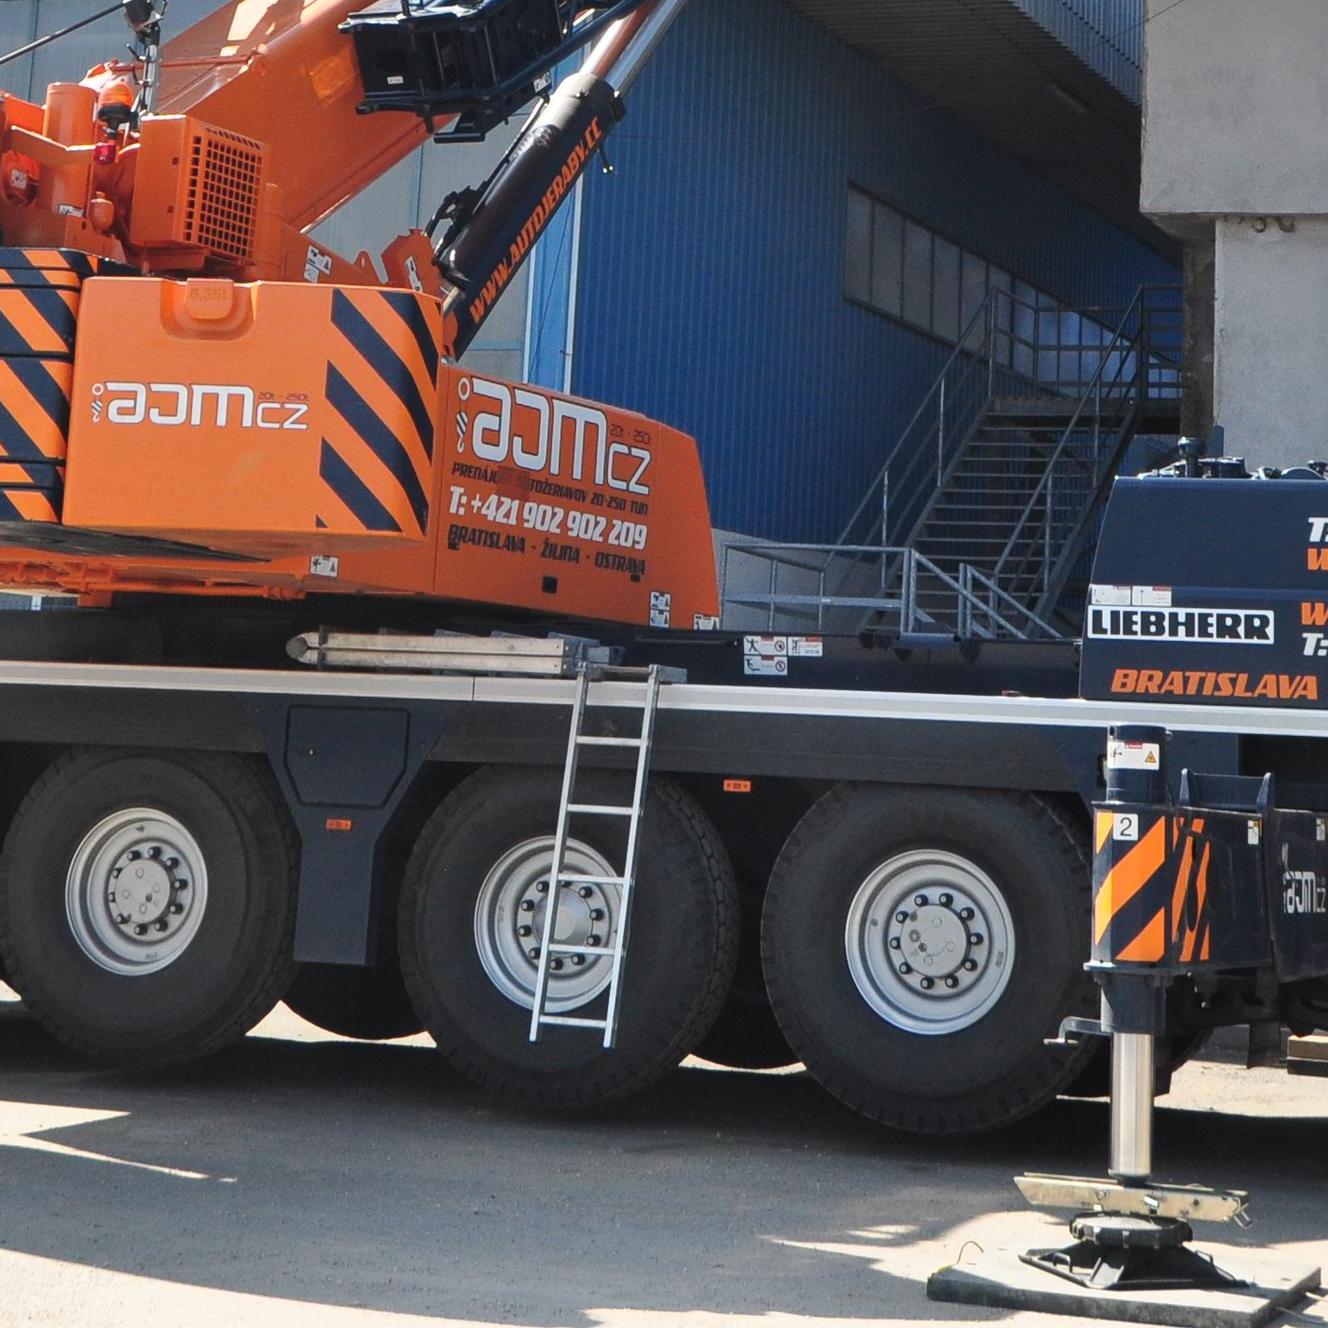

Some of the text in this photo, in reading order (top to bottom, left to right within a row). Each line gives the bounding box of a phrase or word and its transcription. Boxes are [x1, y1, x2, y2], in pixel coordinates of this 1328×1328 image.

[469, 116, 602, 323] WWW.AUTOJERABY.CC
[449, 486, 648, 550] T: +421 902 902 209
[449, 524, 525, 553] BRATISLAVA
[594, 552, 646, 575] OSTRAVA
[1091, 610, 1271, 641] LIEBHERR
[1110, 668, 1319, 701] BRATISLAVA
[1120, 818, 1132, 837] 2
